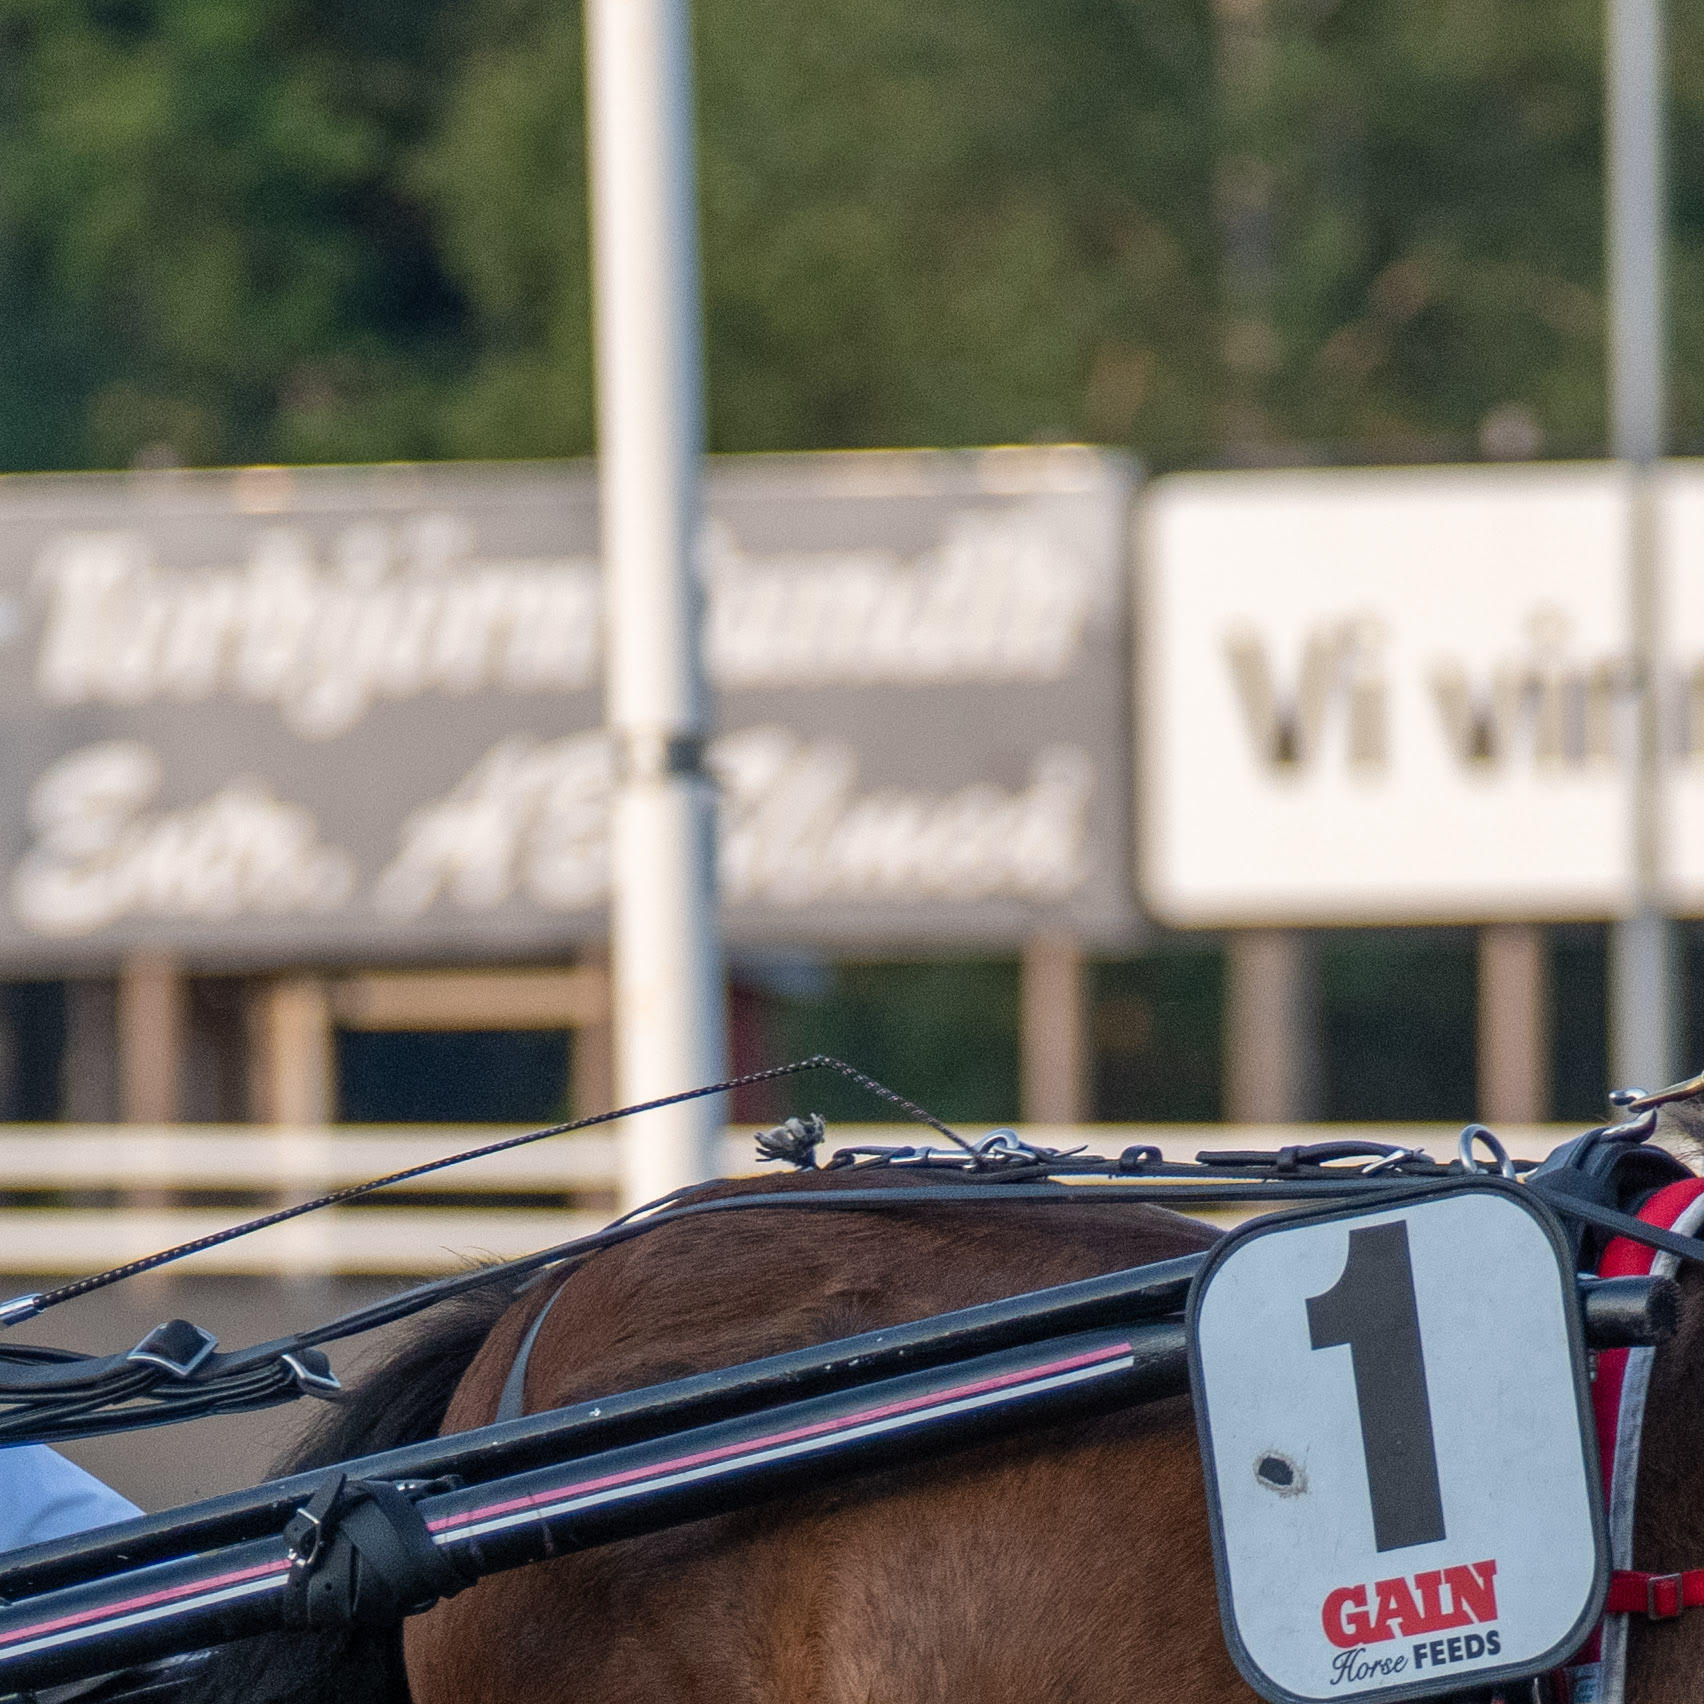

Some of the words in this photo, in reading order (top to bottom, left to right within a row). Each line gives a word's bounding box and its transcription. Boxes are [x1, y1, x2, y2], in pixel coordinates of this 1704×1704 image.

[1218, 607, 1393, 780] Vi
[1304, 1219, 1446, 1553] 1
[1321, 1559, 1499, 1649] GAIN
[1330, 1648, 1409, 1685] Horse
[1412, 1630, 1502, 1669] FEEDS
